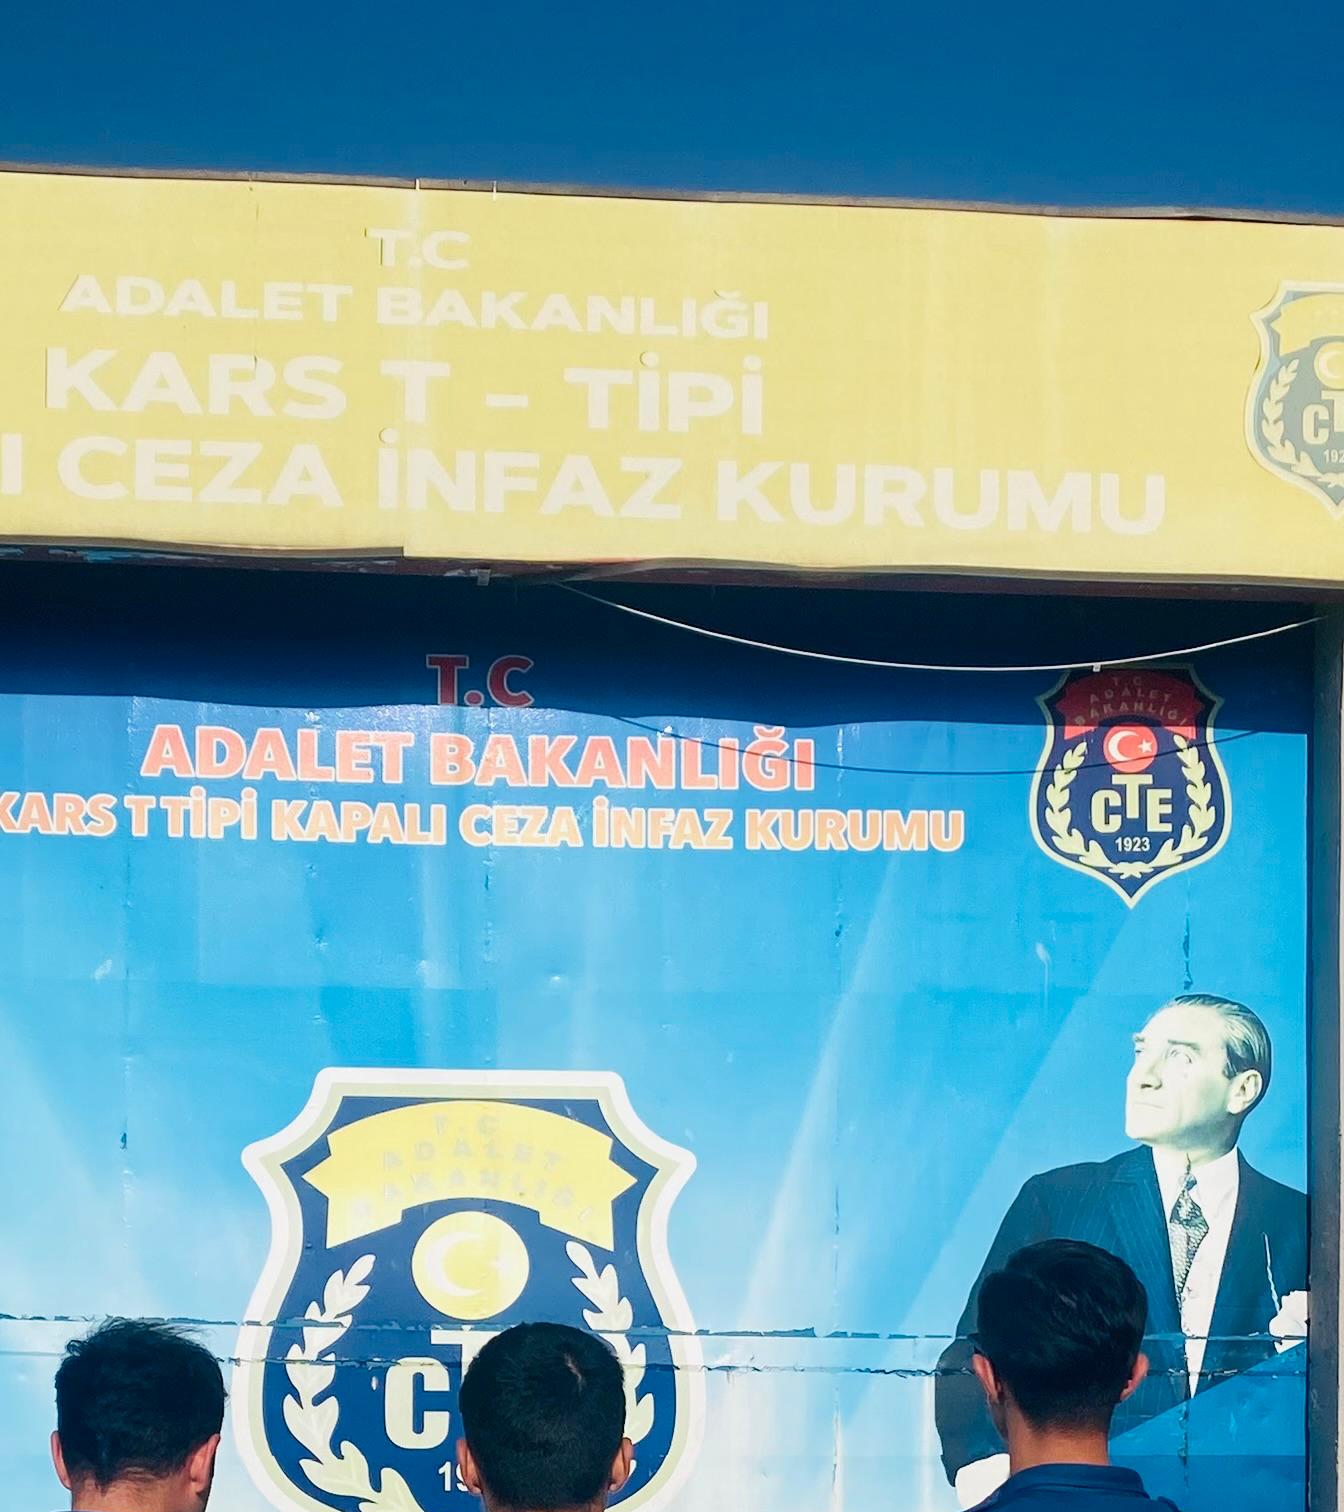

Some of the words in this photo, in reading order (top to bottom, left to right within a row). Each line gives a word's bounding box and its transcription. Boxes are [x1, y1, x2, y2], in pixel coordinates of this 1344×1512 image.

[366, 228, 471, 270] T.C
[59, 275, 354, 322] ADALET
[376, 286, 769, 340] BAKANLIĞI
[45, 346, 348, 420] KARS
[379, 359, 452, 425] T
[562, 350, 765, 437] TİPİ
[56, 434, 345, 508] CEZA
[376, 426, 684, 521] İNFAZ
[714, 458, 1168, 537] KURUMU
[140, 723, 415, 784] ADALET
[428, 725, 816, 792] BAKANLIĞI
[160, 784, 259, 841] TİPİ
[269, 798, 449, 846] KAPALI
[458, 803, 584, 848] CEZA
[591, 794, 735, 851] İNFAZ
[744, 808, 966, 851] KURUMU
[1114, 836, 1151, 852] 1923
